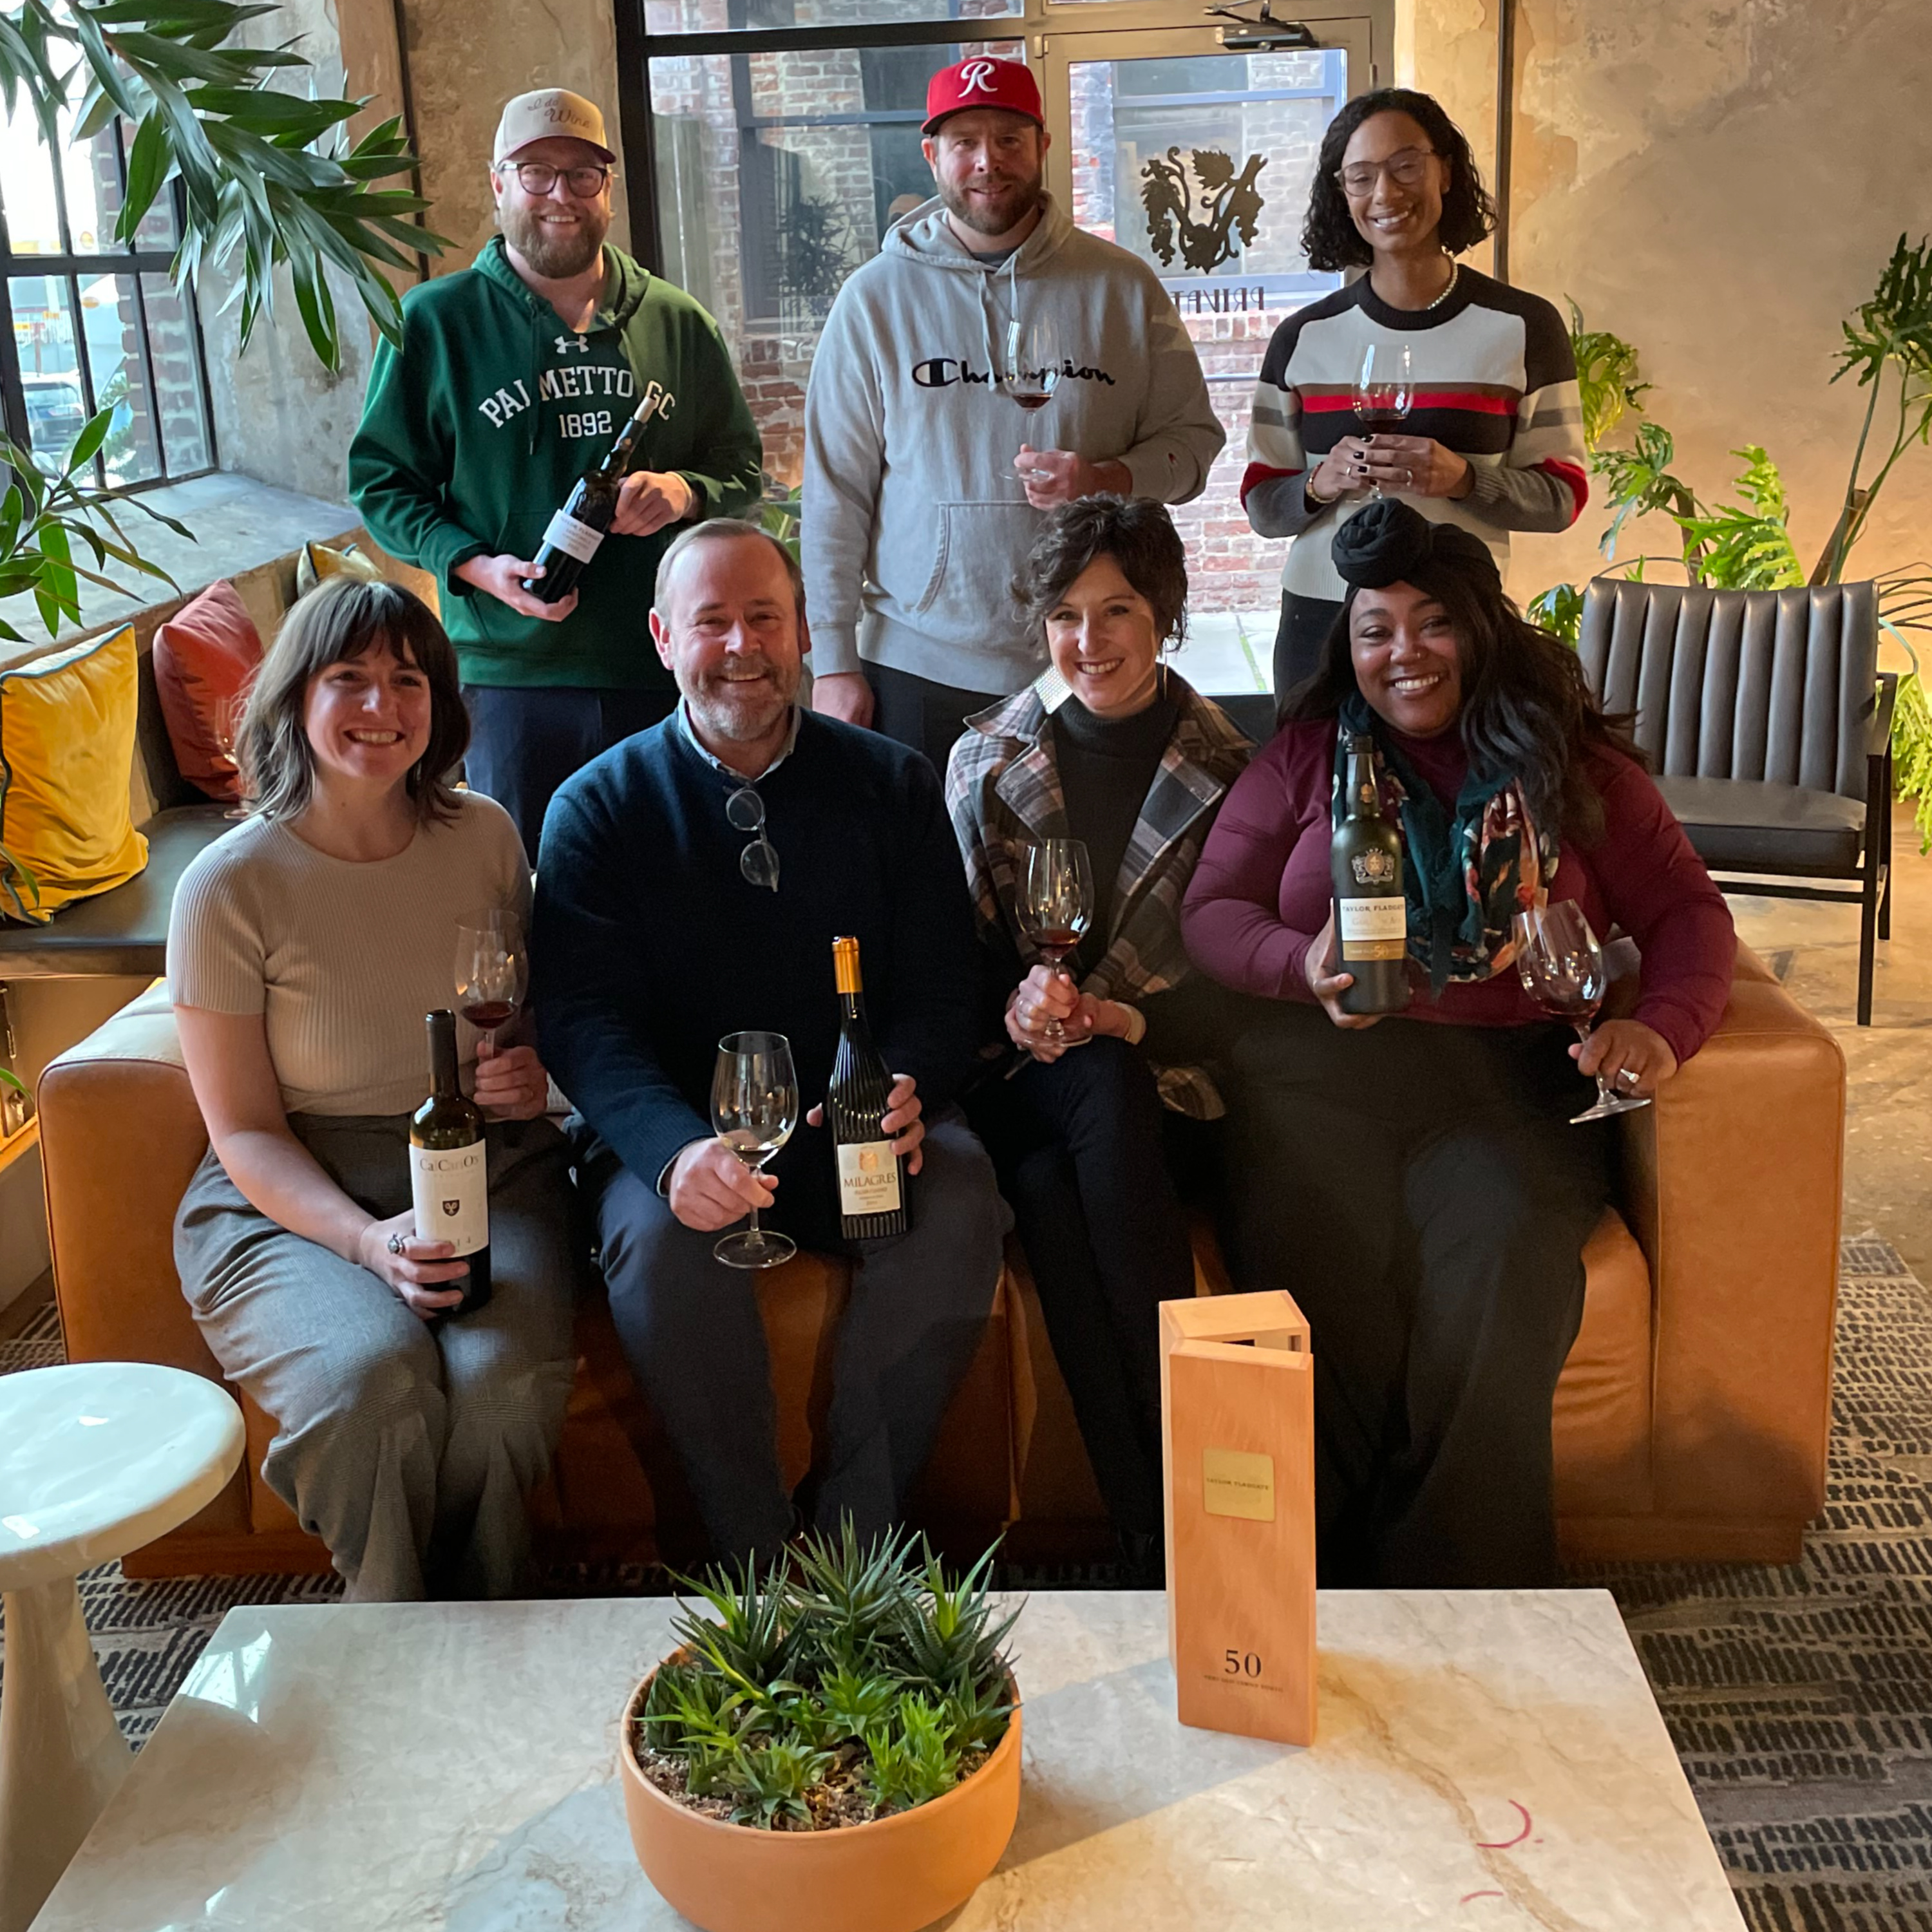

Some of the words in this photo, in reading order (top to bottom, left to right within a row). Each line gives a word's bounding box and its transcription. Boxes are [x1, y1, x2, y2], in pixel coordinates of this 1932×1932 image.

[958, 61, 998, 98] R
[544, 97, 559, 108] do
[544, 108, 589, 129] Wine
[559, 410, 613, 438] 1892
[844, 1172, 896, 1188] MILAGRES
[1224, 1649, 1262, 1678] 50
